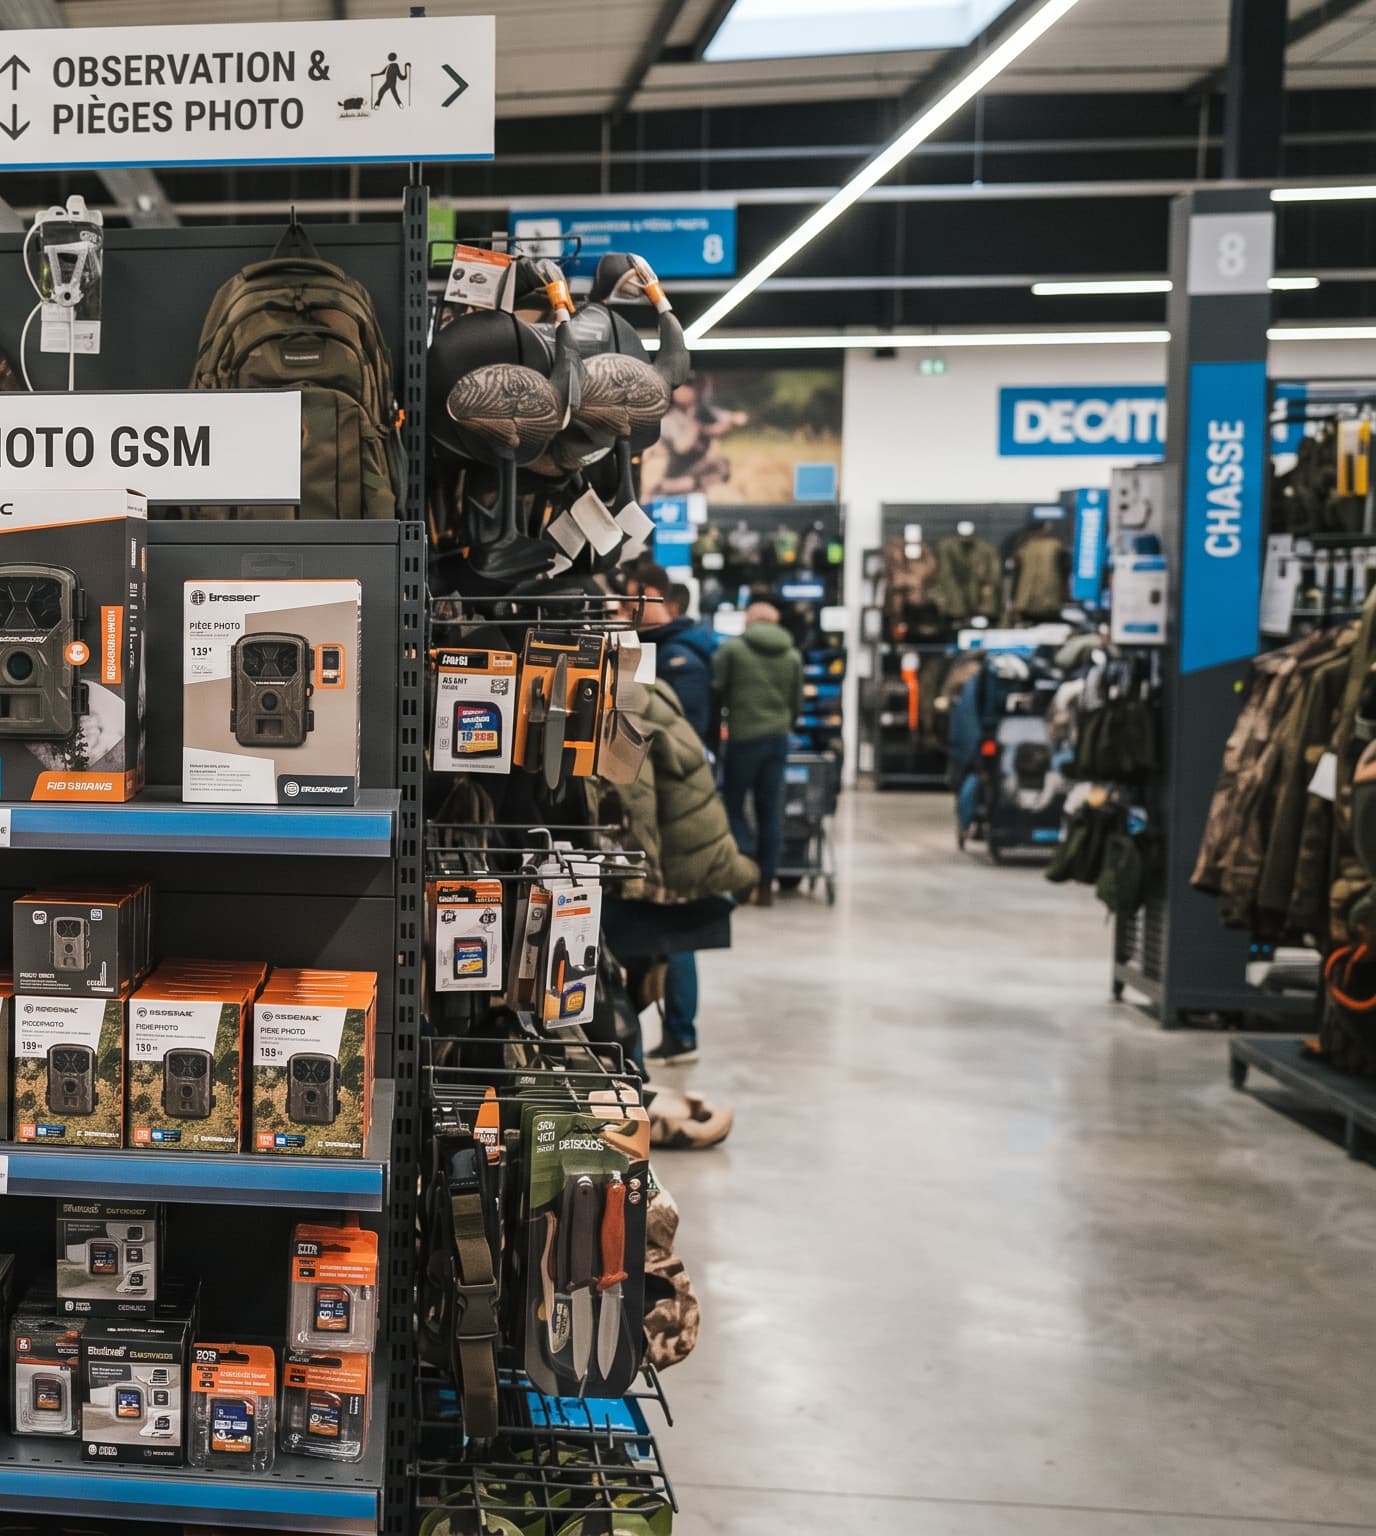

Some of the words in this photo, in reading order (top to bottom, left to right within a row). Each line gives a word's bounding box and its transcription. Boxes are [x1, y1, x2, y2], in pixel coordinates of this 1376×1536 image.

[52, 51, 295, 89] OBSERVATION
[308, 50, 330, 82] &
[53, 95, 175, 136] PIÈGES
[186, 97, 304, 132] PHOTO
[1218, 232, 1245, 277] 8
[110, 425, 211, 467] GSM
[1205, 419, 1245, 558] CHASSE
[214, 622, 241, 630] PHOTO
